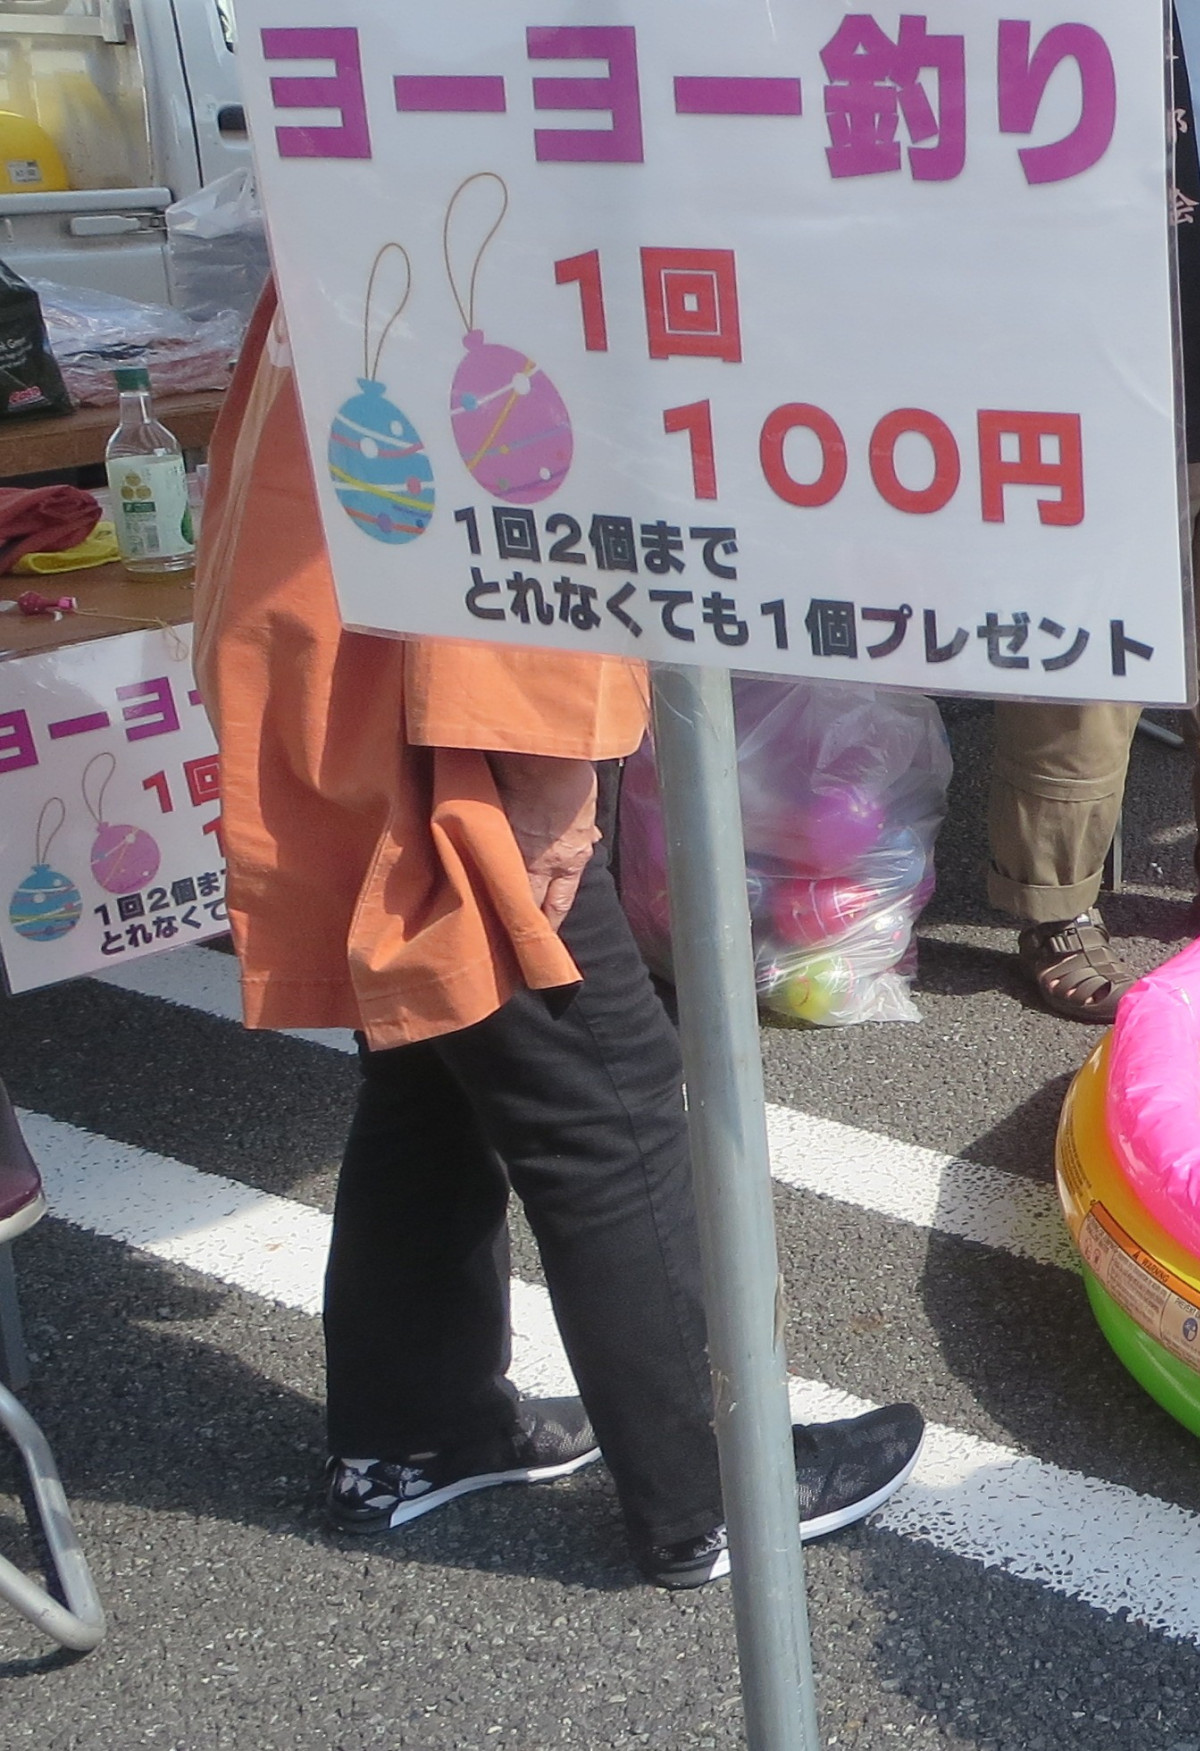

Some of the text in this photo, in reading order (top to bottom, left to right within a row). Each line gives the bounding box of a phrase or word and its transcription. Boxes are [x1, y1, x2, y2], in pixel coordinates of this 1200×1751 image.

[261, 14, 1116, 185] ヨーヨー釣り
[555, 248, 742, 363] 1回
[664, 399, 1085, 526] 100円
[454, 507, 740, 581] 1回2個まで
[465, 568, 1155, 677] とれなくても1個プレゼント
[0, 676, 203, 773] ヨーヨ
[94, 869, 226, 926] 1回2個ま
